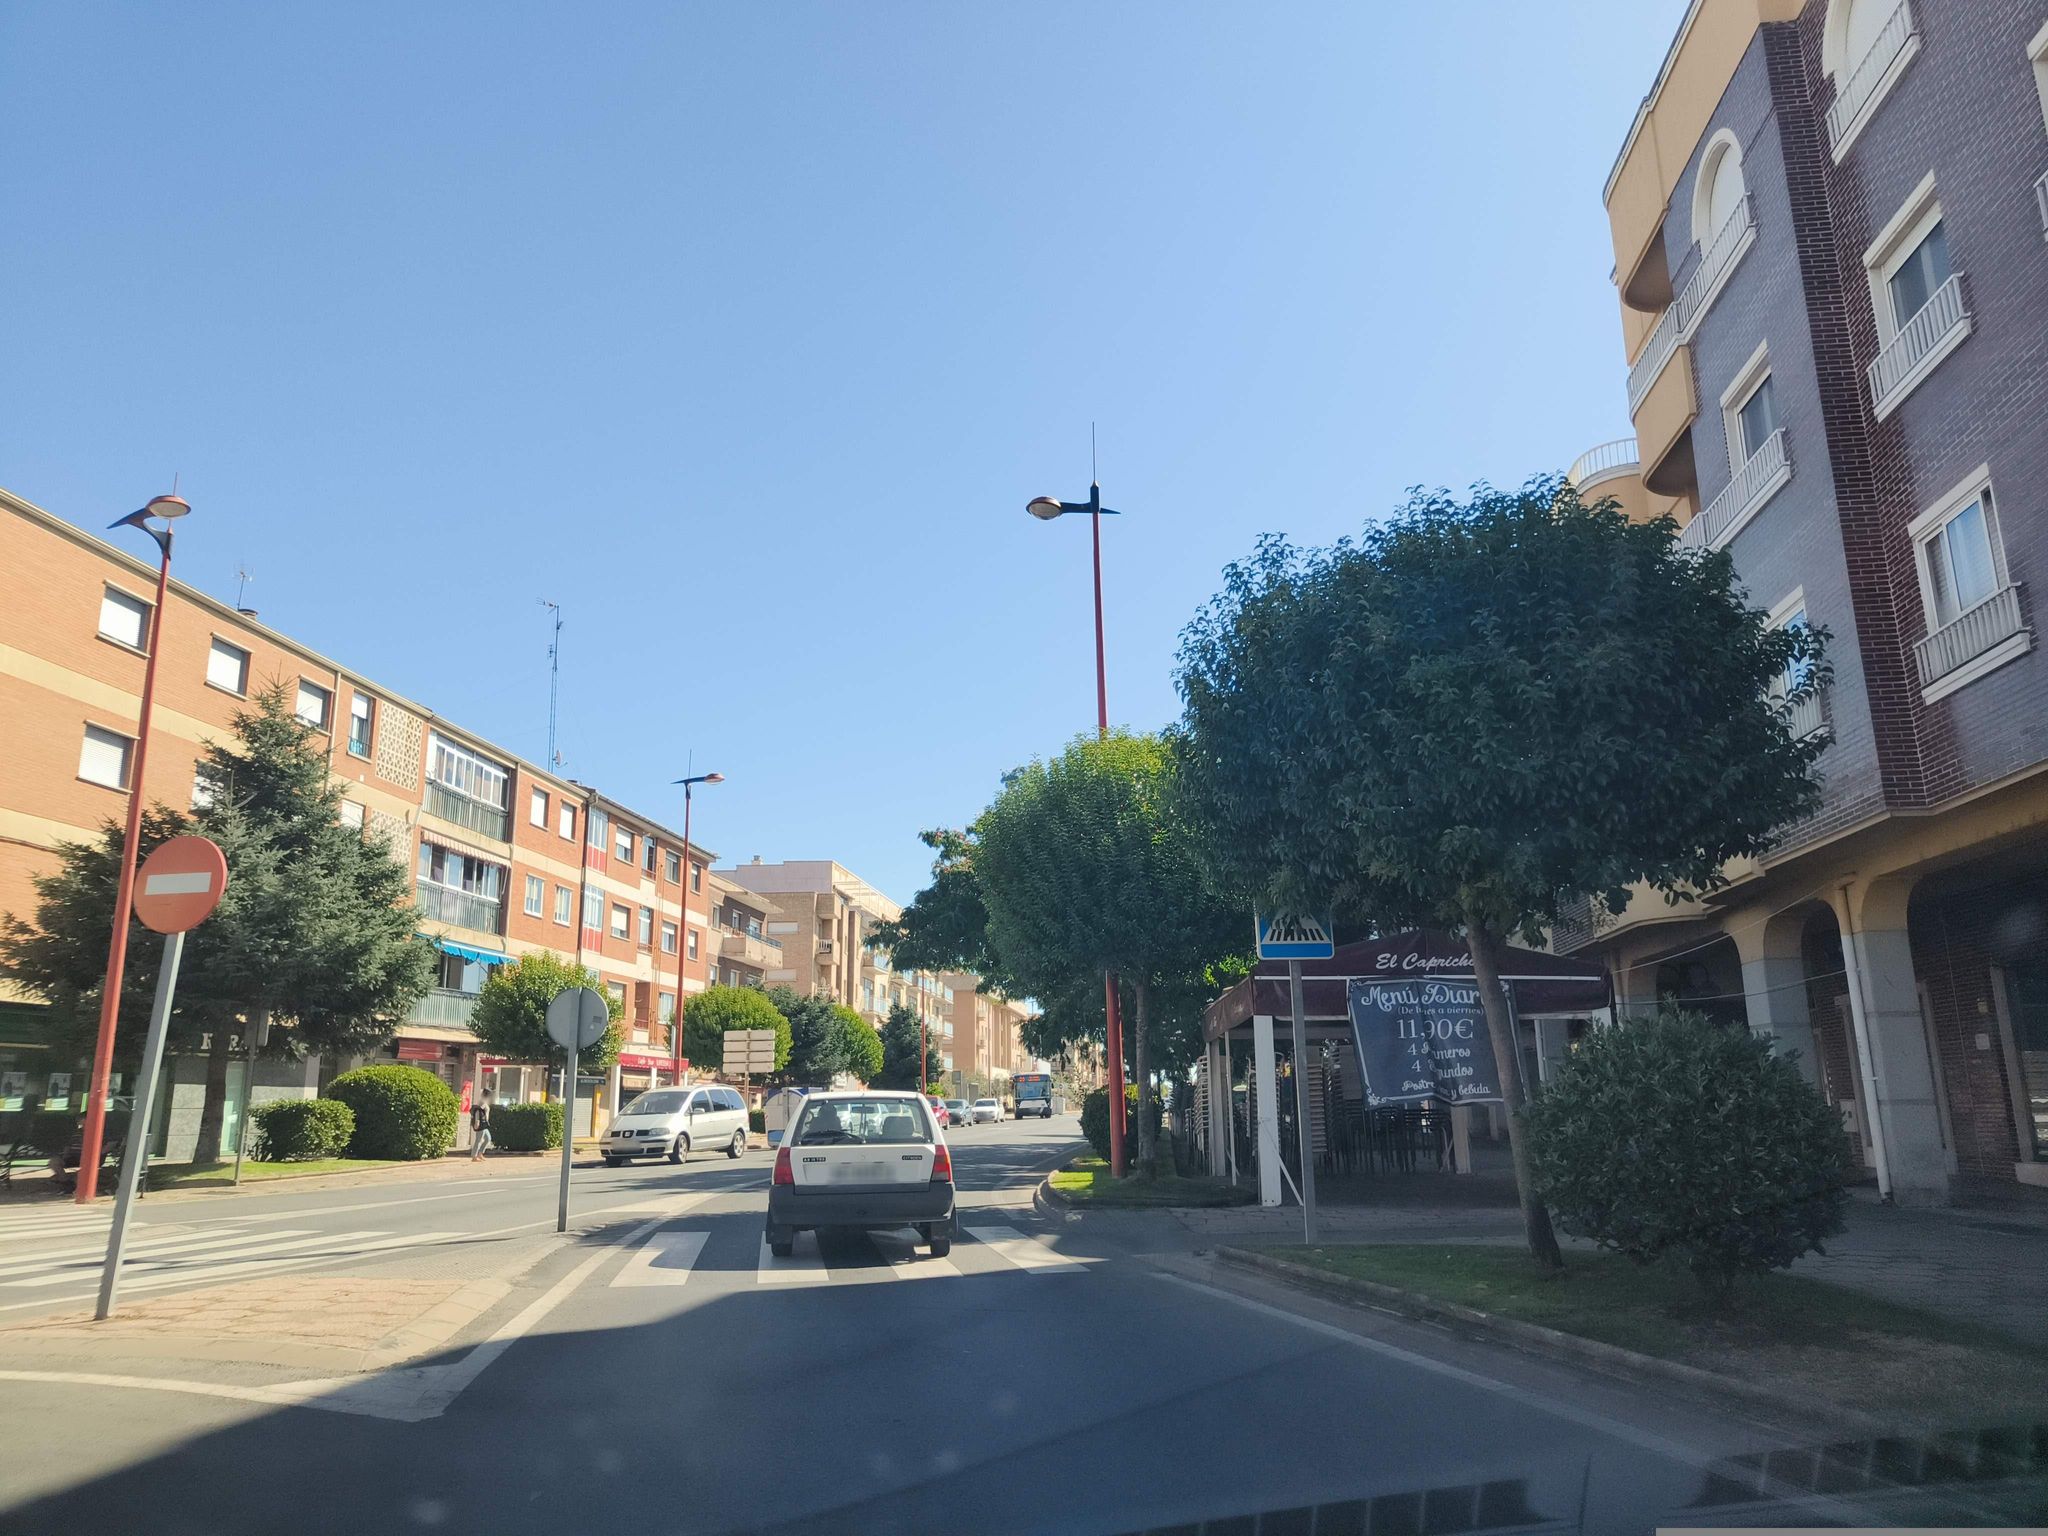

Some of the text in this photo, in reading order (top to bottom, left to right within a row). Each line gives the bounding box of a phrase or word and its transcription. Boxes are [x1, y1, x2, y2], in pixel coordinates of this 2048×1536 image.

[1375, 952, 1398, 969] El
[1361, 983, 1480, 1012] Menú Diar
[1396, 1018, 1474, 1040] 11,90€
[1408, 1042, 1418, 1056] 4
[1411, 1059, 1422, 1073] 4
[1458, 1083, 1492, 1096] bebida
